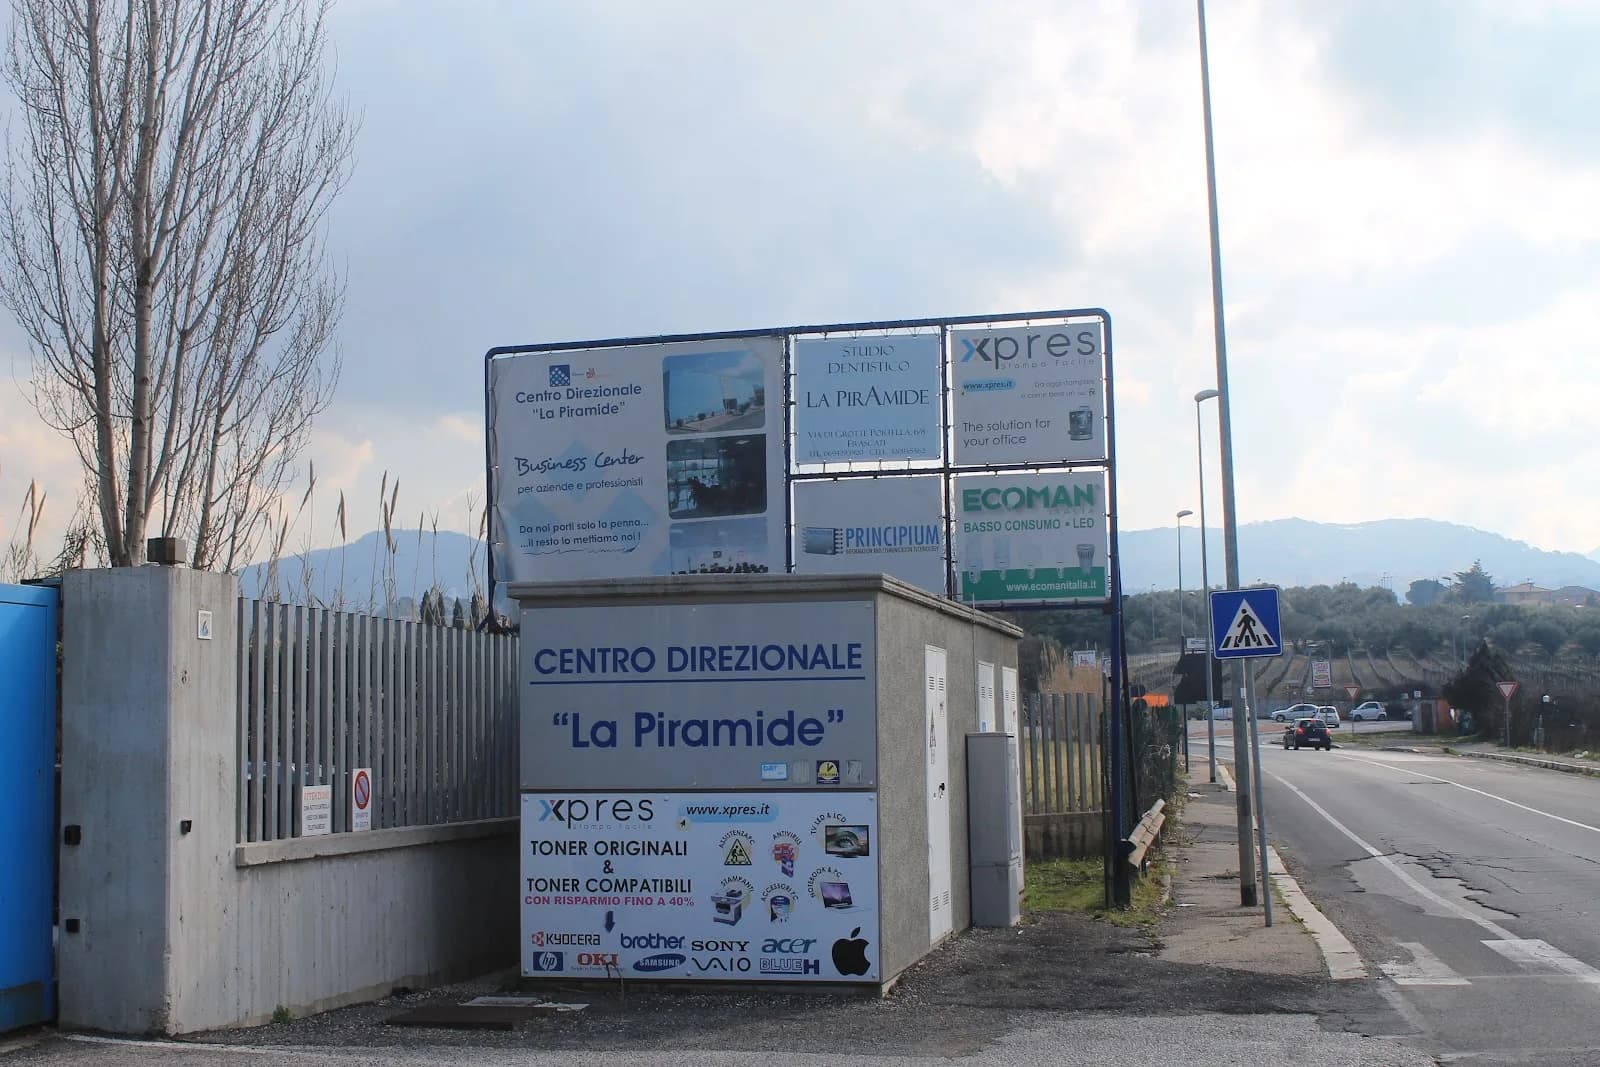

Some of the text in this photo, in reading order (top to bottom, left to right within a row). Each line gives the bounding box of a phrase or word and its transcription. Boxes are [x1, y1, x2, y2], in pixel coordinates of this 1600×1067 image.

[843, 345, 895, 357] STUDIO
[960, 331, 1095, 370] xpres
[828, 361, 910, 374] DENTISTICO
[963, 380, 1012, 390] www.xpres.it
[516, 384, 642, 403] Centro Direzionale
[807, 385, 929, 408] LA PIRAMIDE
[533, 402, 625, 419] "La Piramide"
[963, 418, 1051, 432] The solution for
[963, 434, 1026, 448] your office
[514, 448, 644, 476] Business Center
[518, 486, 533, 495] per
[536, 482, 574, 493] aziende
[585, 478, 643, 492] professionisti
[963, 484, 1094, 512] ECOMAN
[520, 519, 648, 533] Da noi porti solo la penna...
[964, 517, 1095, 533] BASSO CONSUMO LED
[536, 537, 559, 547] resto
[562, 536, 571, 545] lo
[573, 534, 618, 545] mettiamo
[621, 532, 636, 541] noi
[846, 525, 939, 547] PRINCIPIUM
[1006, 580, 1096, 592] www.ecomanitalia.it
[534, 643, 862, 674] CENTRO DIREZIONALE
[553, 709, 844, 748] “La Piramide”
[538, 798, 654, 829] xpres
[686, 803, 770, 816] www.xpres.it
[810, 825, 818, 835] TV
[815, 814, 825, 826] LED
[833, 812, 847, 823] LCD
[718, 829, 748, 848] ASSISTENZA
[772, 830, 802, 846] ANTIVIRUS
[531, 841, 687, 856] TONER ORIGINALI
[603, 860, 614, 874] &
[527, 878, 691, 893] TONER COMPATIBILI
[720, 875, 754, 892] STAMPANTI
[807, 867, 826, 898] NOTEBOOK
[834, 869, 843, 878] PC
[761, 883, 798, 902] ACCESSORI PC
[525, 896, 695, 906] CON RISPARMIO FINO A 40%
[546, 933, 600, 945] KYOCERA
[621, 933, 685, 949] brother
[691, 940, 750, 951] SONY
[761, 938, 817, 954] acer
[541, 952, 556, 969] hp
[578, 953, 619, 966] OKI
[639, 958, 680, 967] SAMSUNG
[691, 957, 751, 972] VAIO
